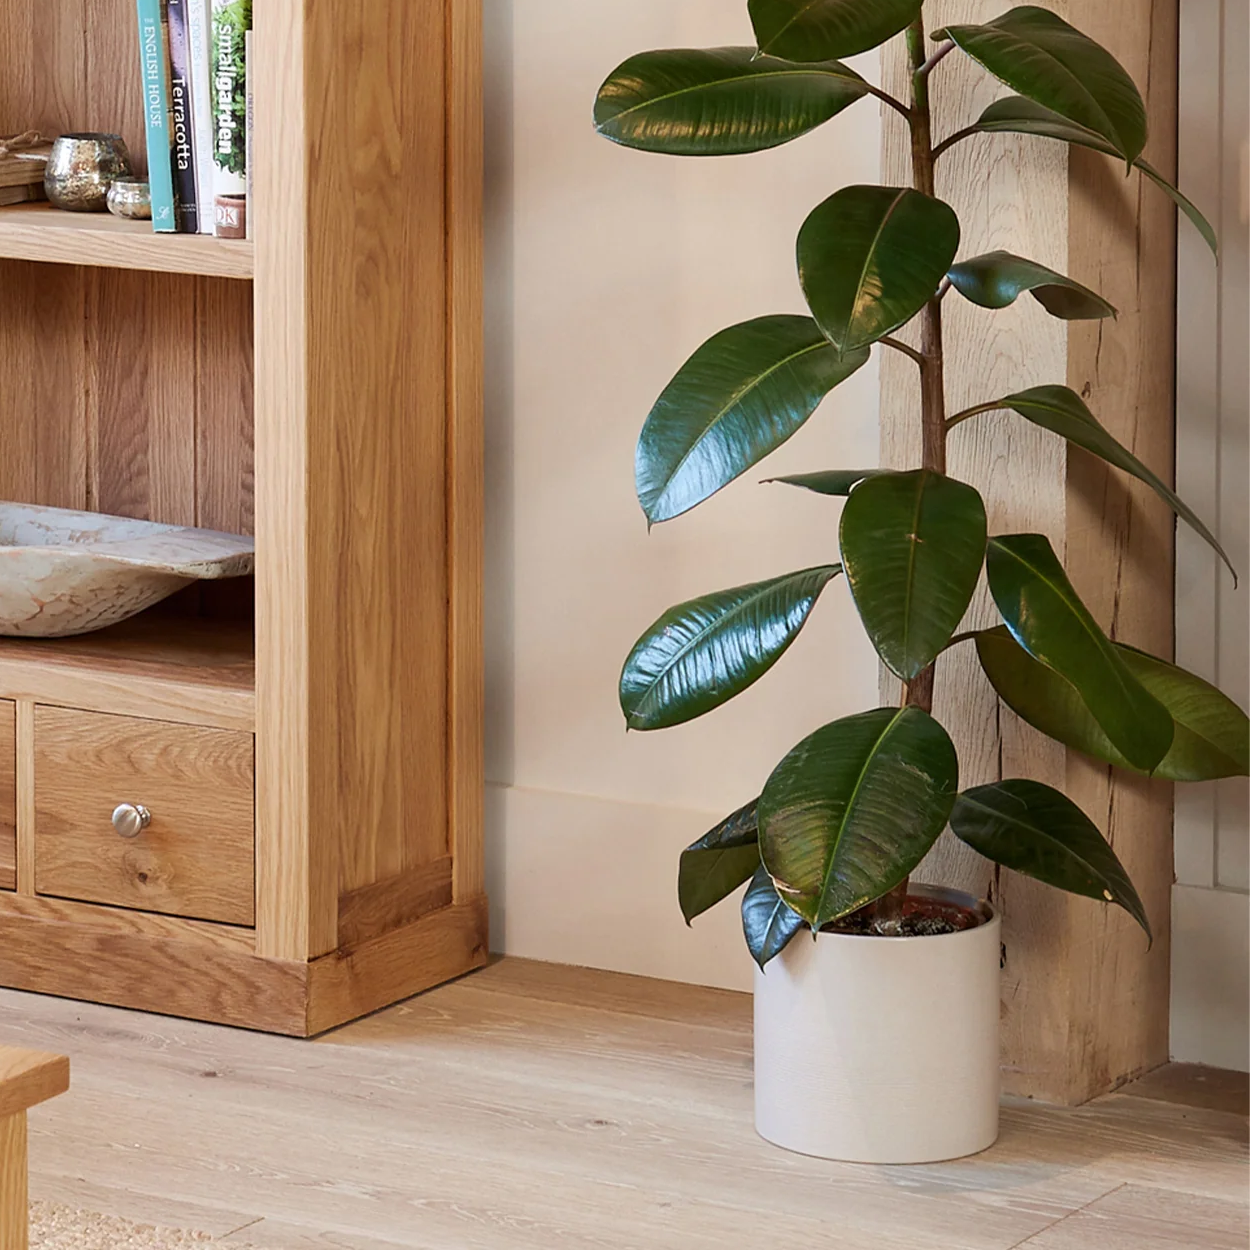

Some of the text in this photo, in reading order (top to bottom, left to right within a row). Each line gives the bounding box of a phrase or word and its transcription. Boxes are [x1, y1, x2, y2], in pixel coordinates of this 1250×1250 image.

[144, 26, 159, 80] ENGLISH
[189, 17, 203, 60] spaces
[149, 84, 162, 128] HOUSE
[172, 76, 191, 170] Terracotta
[214, 206, 235, 224] DK
